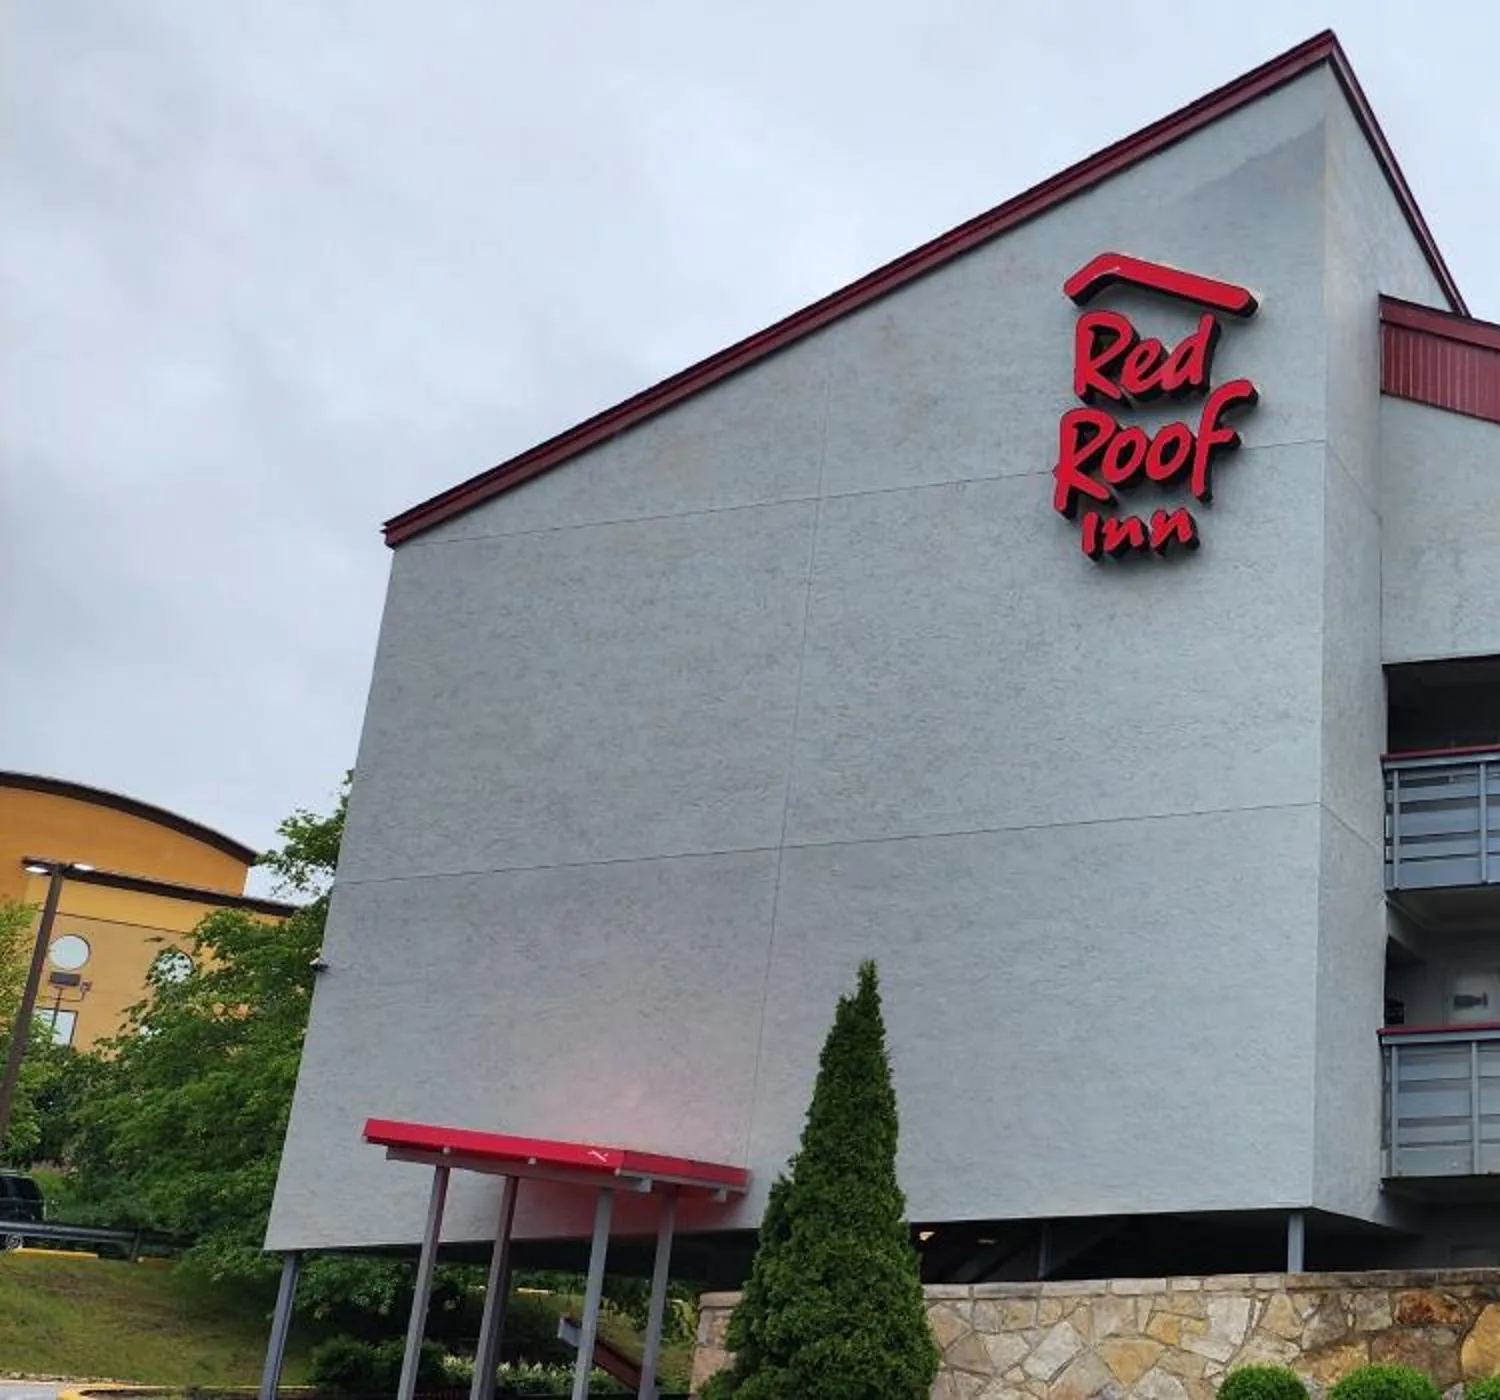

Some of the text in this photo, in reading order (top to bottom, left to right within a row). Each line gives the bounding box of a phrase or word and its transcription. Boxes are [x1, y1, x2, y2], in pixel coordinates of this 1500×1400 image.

[1073, 310, 1216, 400] Red
[1053, 379, 1255, 513] Roof
[1081, 508, 1196, 556] Inn
